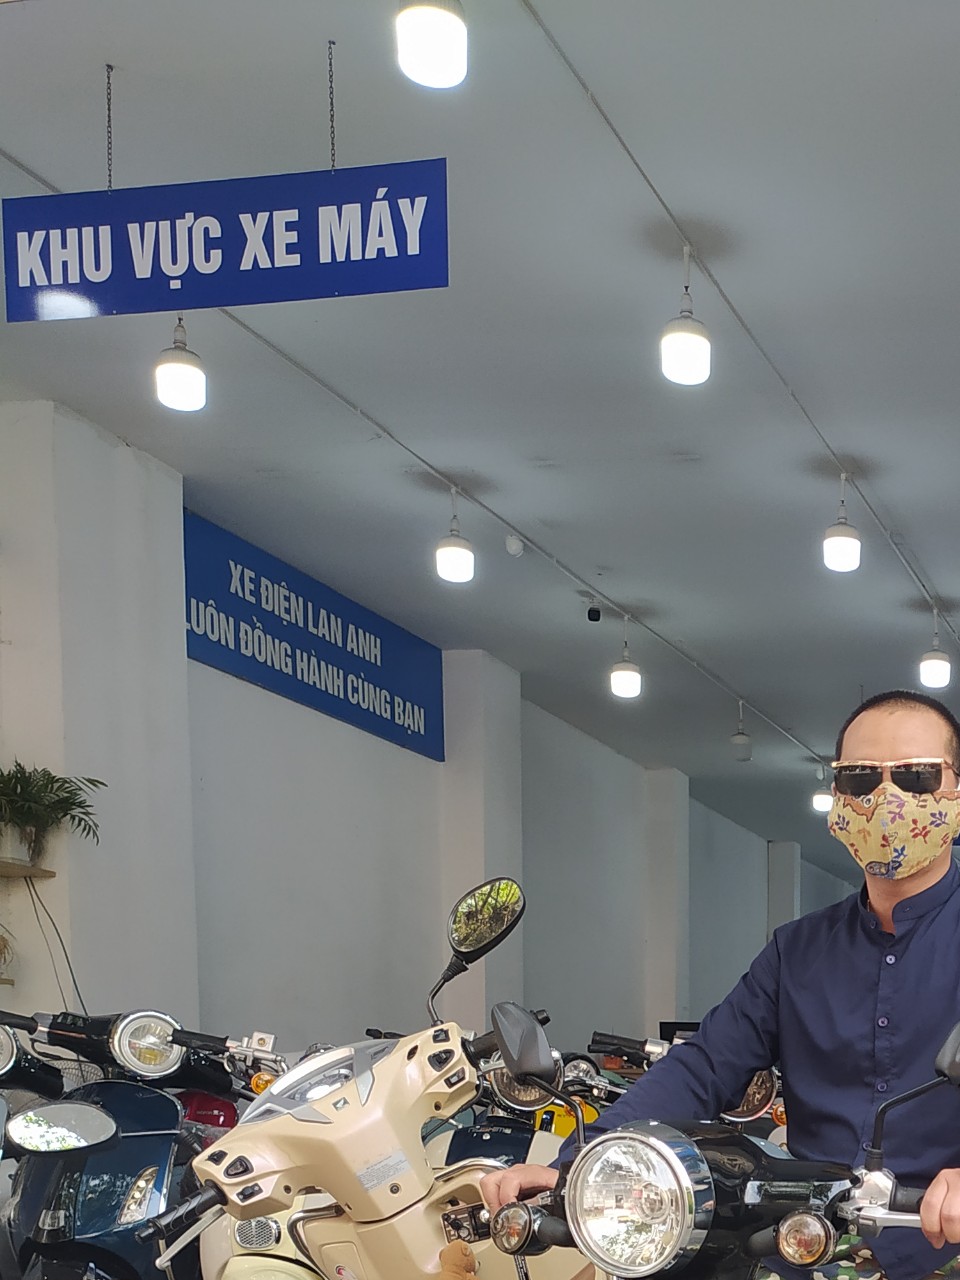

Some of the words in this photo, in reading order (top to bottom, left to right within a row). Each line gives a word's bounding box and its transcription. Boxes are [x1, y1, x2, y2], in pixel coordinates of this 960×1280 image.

[16, 224, 113, 288] KHU
[127, 212, 223, 290] VỰC
[239, 208, 301, 271] XE
[318, 187, 428, 264] MÁY
[228, 559, 256, 605] XE
[259, 576, 304, 628] ĐIỆN
[307, 601, 343, 648] LAN
[346, 623, 382, 667] ANH
[239, 615, 293, 676] ĐỒNG
[295, 648, 345, 700] HÀNH
[347, 672, 391, 721] CÙNG
[394, 695, 425, 736] BẠN
